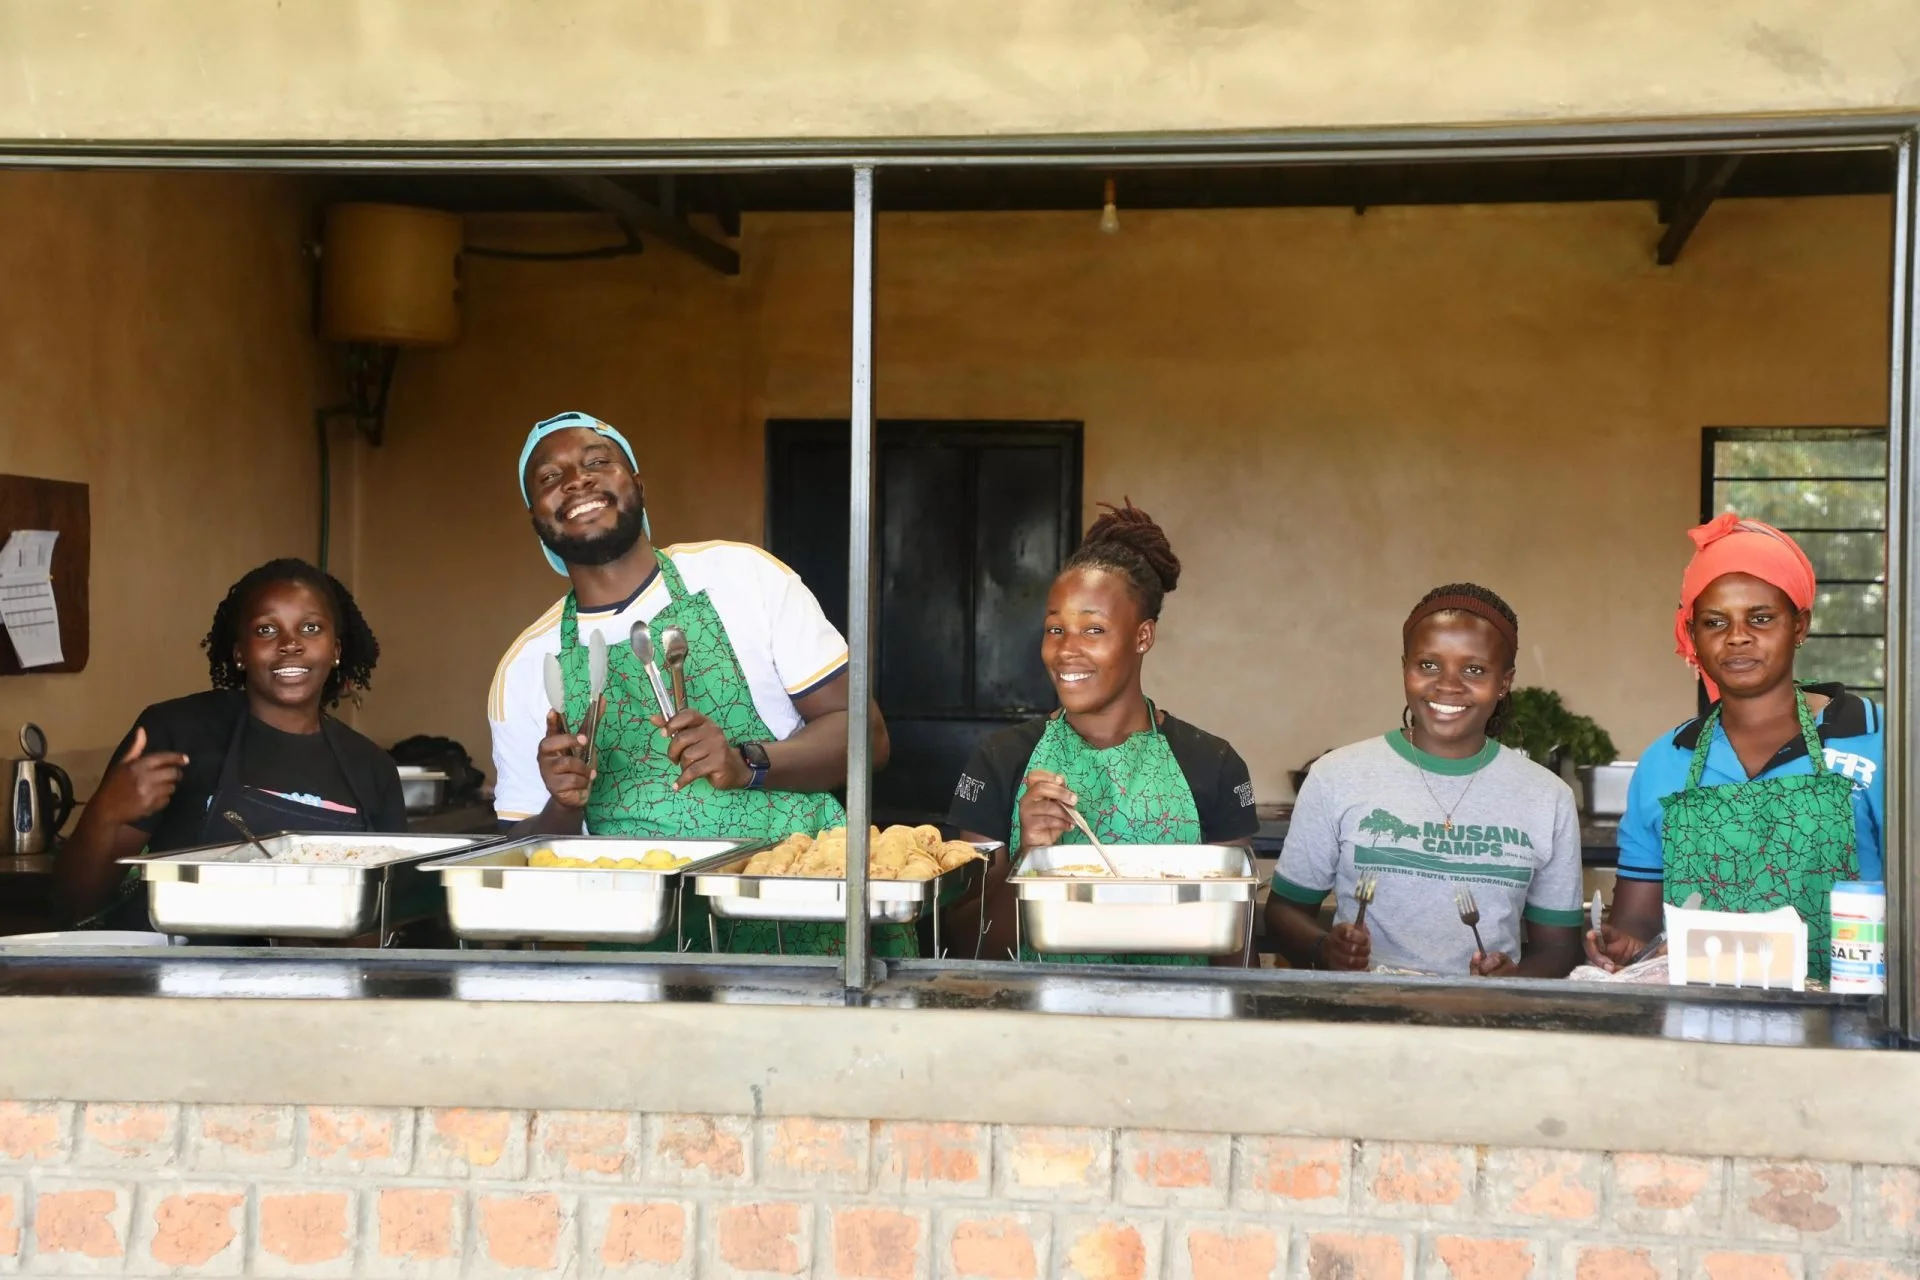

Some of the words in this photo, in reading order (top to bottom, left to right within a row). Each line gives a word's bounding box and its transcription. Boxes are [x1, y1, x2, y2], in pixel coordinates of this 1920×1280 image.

[1423, 821, 1535, 850] MUSANA
[1422, 838, 1504, 857] CAMPS
[1450, 875, 1514, 888] TRANSFORMING
[1831, 945, 1872, 961] SALT
